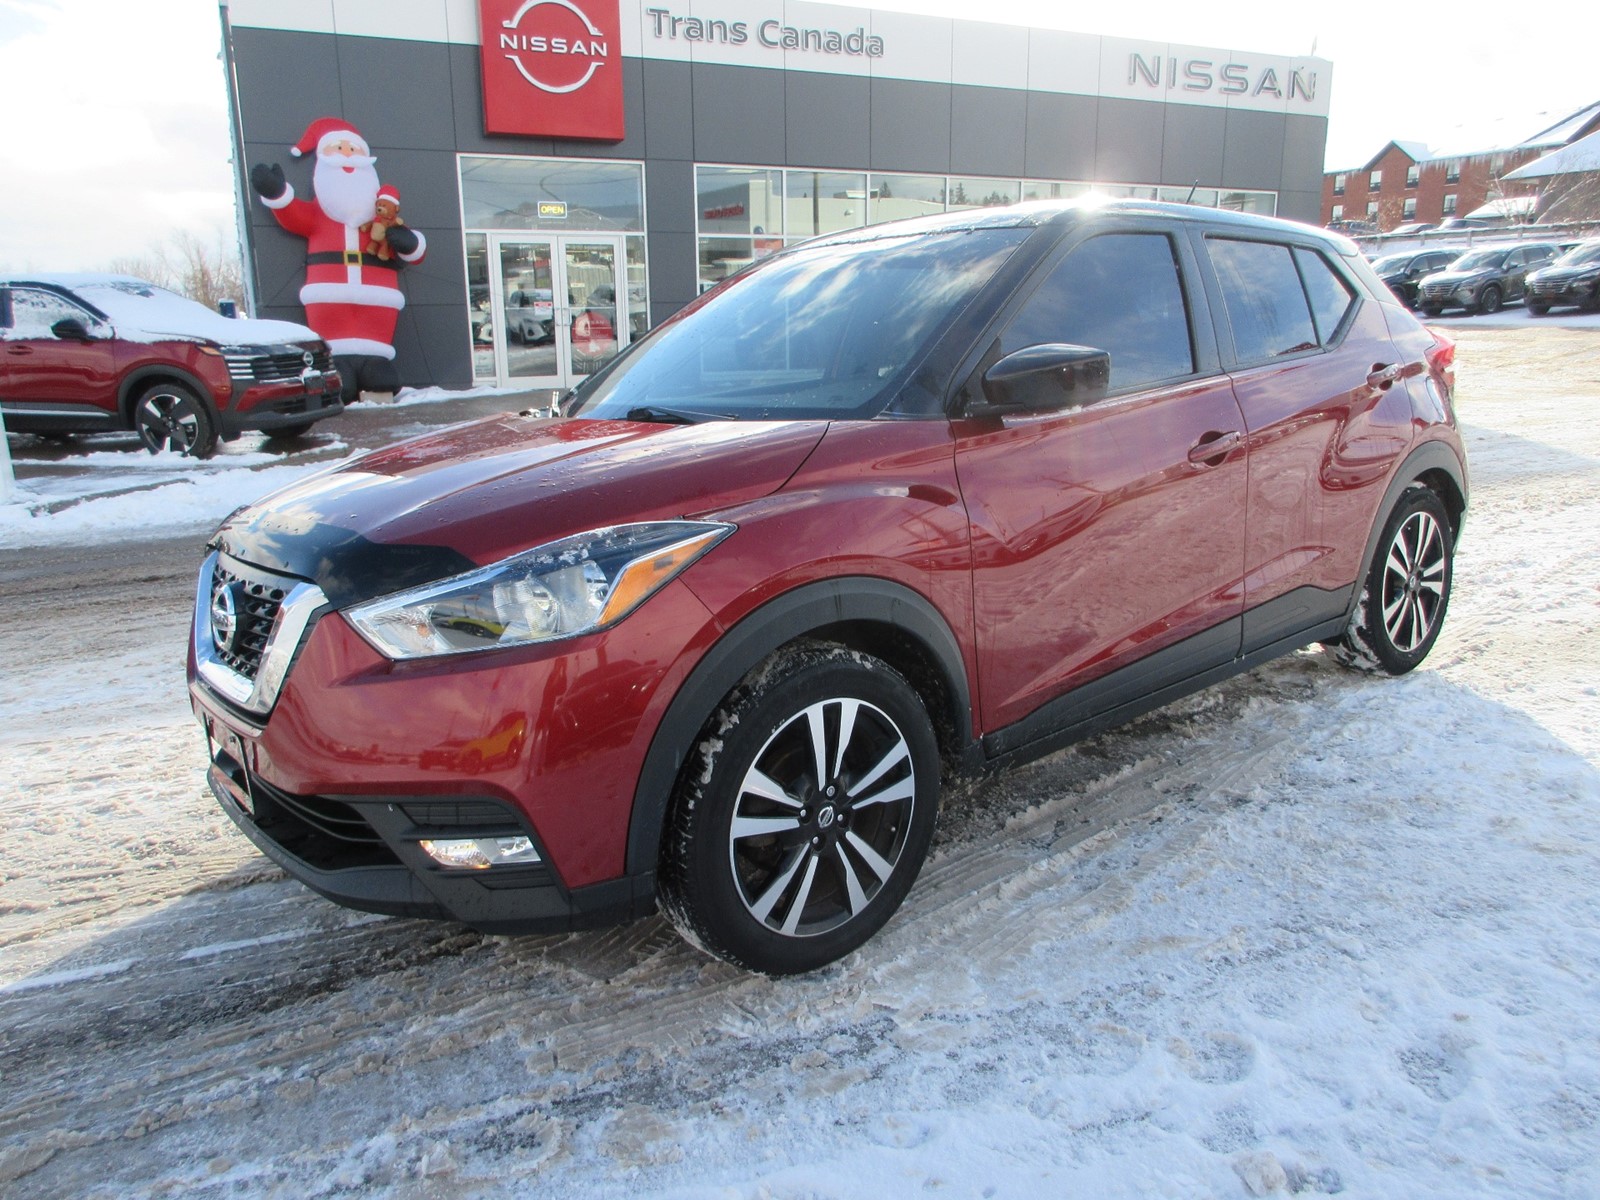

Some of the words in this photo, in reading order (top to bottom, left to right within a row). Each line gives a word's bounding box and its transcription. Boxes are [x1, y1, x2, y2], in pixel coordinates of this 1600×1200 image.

[500, 33, 608, 57] NISSAN
[646, 8, 749, 45] Trans
[758, 19, 885, 57] Canada
[1128, 53, 1317, 101] NISSAN
[540, 205, 565, 214] OPEN
